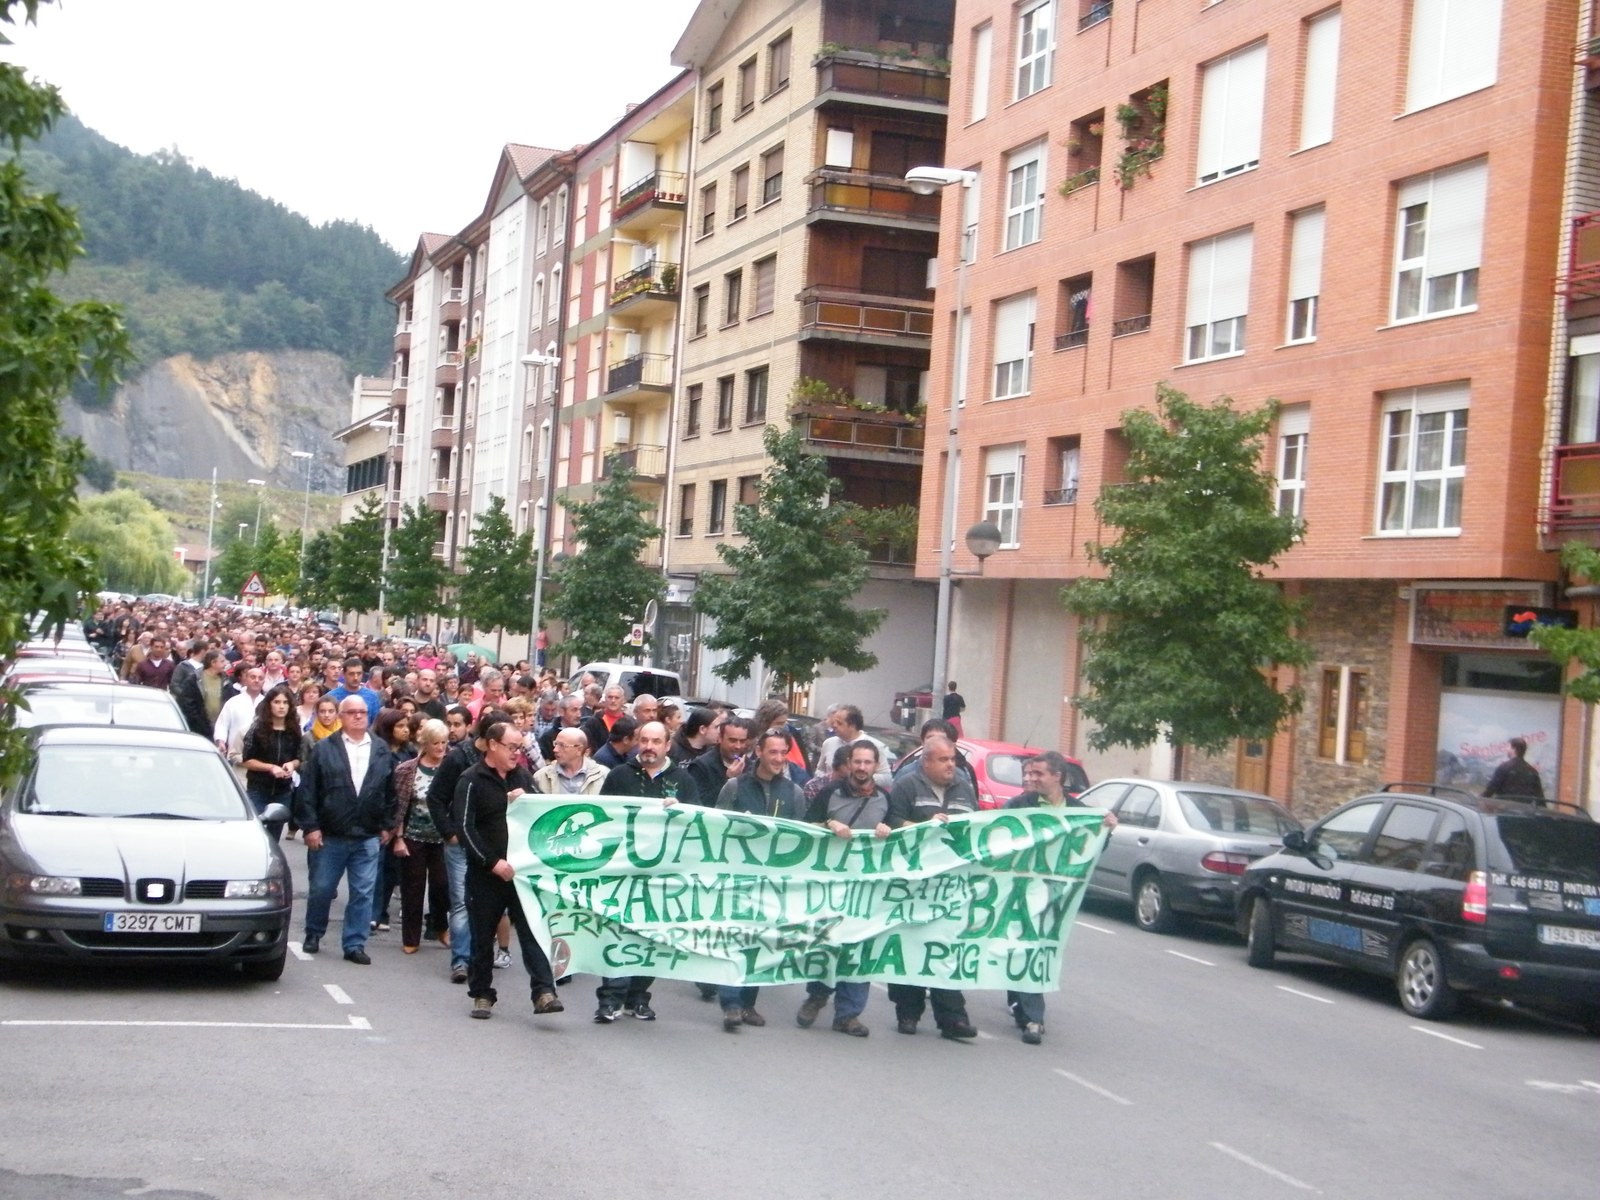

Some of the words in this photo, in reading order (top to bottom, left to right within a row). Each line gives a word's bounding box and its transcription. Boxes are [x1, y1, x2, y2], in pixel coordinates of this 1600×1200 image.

[528, 803, 932, 873] GUARDIAN
[1510, 876, 1526, 889] 646
[1544, 879, 1559, 893] 923
[118, 915, 158, 931] 3297
[162, 916, 195, 931] CMT
